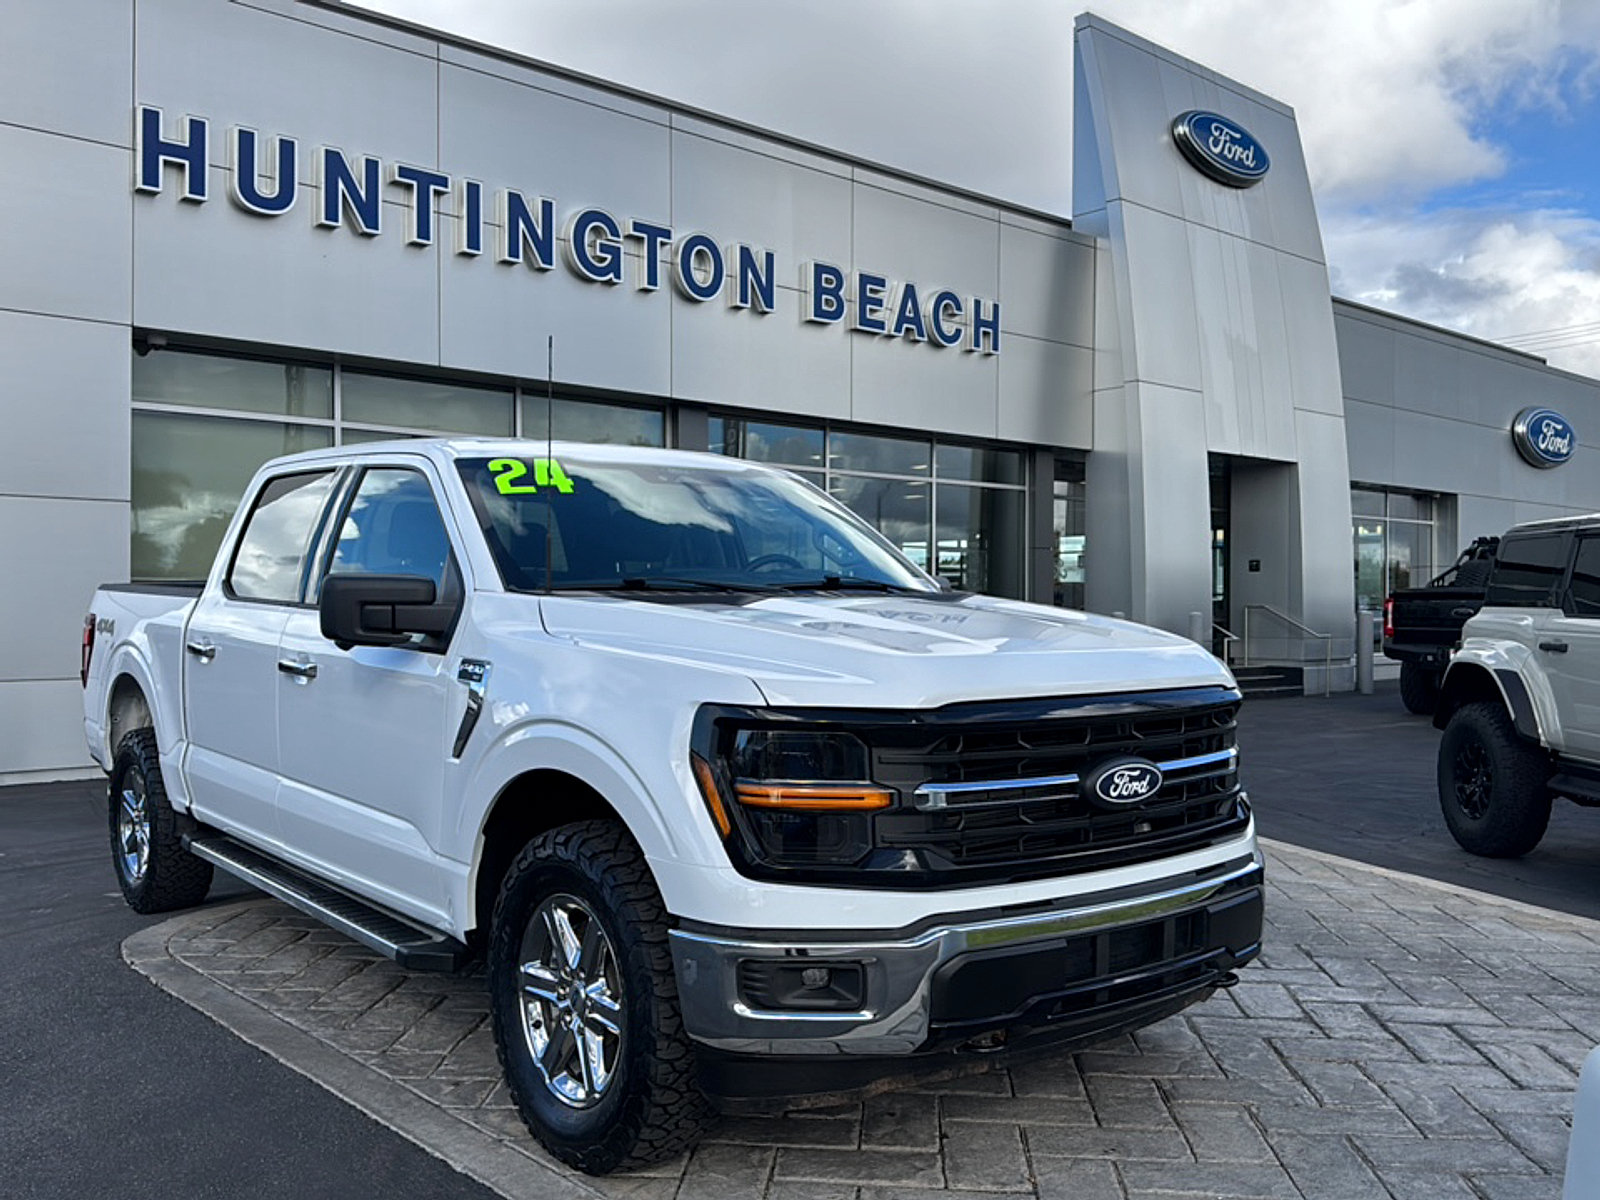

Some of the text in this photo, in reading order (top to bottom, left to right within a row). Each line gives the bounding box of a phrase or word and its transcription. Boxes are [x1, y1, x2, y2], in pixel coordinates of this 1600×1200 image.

[1208, 122, 1256, 168] Ford
[135, 104, 1001, 356] HUNTINGTON BEACH
[1538, 419, 1570, 454] Ford
[487, 458, 575, 495] 24
[1109, 769, 1150, 797] Ford
